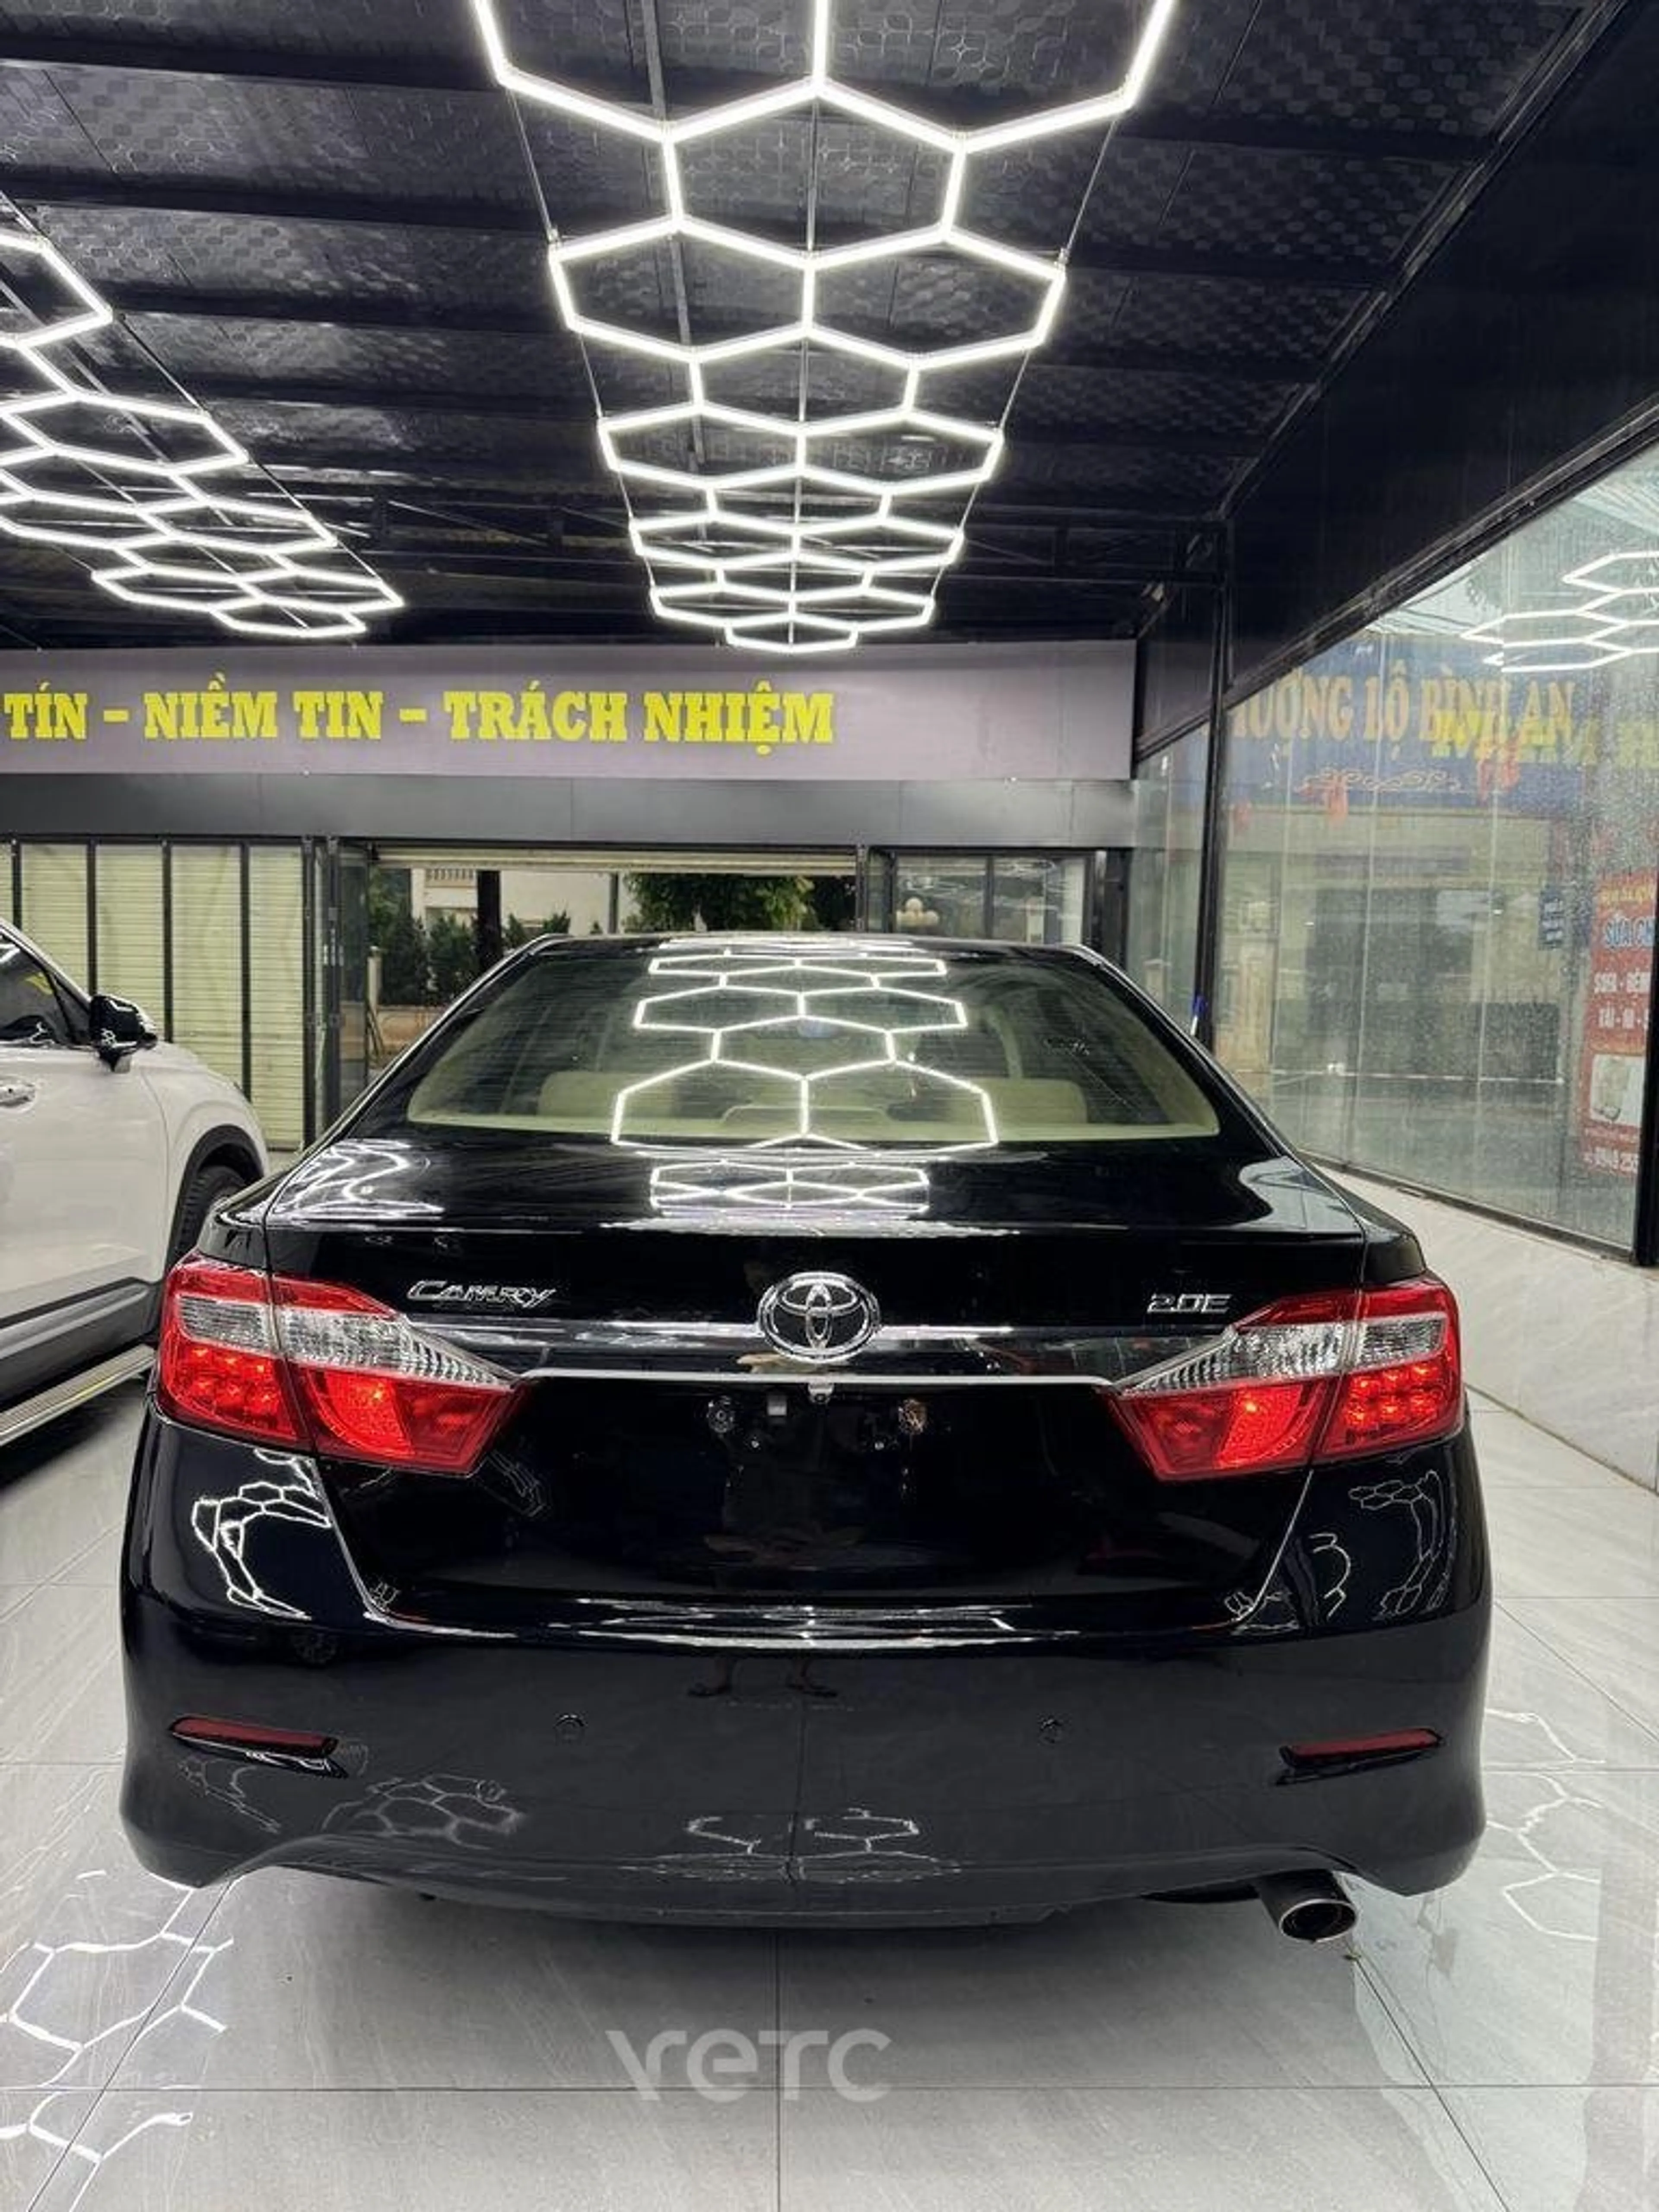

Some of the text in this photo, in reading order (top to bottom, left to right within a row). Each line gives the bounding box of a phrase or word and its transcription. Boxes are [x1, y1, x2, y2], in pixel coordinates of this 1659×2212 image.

[3, 681, 87, 740] TÍN
[143, 672, 278, 739] NIỀM
[292, 691, 384, 739] TIN
[443, 680, 629, 742] TRÁCH
[642, 680, 833, 756] NHIỆM
[407, 1280, 556, 1308] CAMRY
